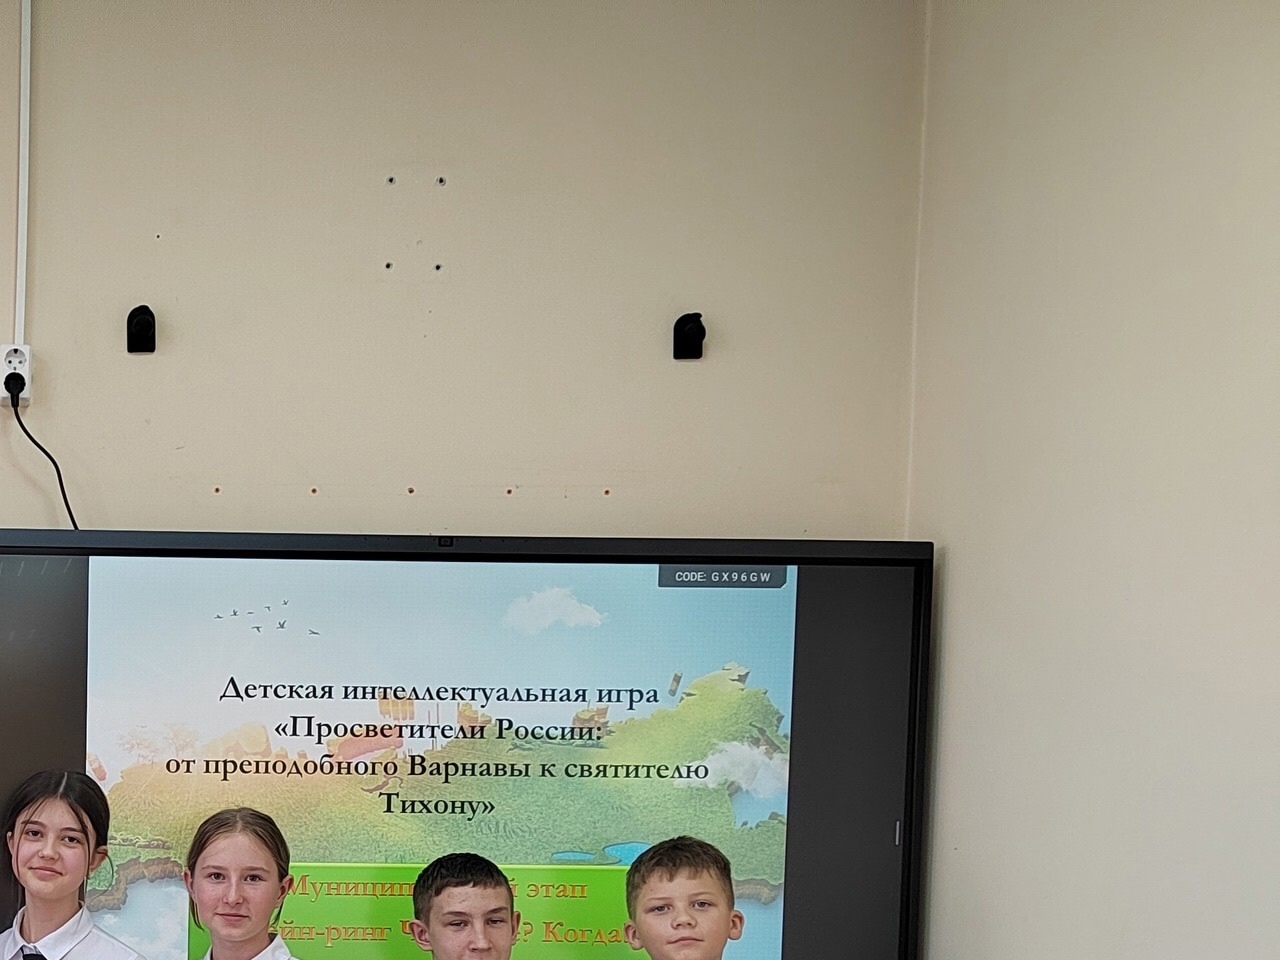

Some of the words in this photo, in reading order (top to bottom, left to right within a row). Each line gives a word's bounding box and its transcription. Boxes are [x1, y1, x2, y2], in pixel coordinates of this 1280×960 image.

[675, 572, 706, 581] CODE:
[219, 677, 334, 704] Детская
[343, 683, 587, 709] интеллектуальная
[596, 687, 659, 711] игра
[274, 714, 485, 741] «Просветители
[495, 718, 604, 741] России:
[165, 758, 195, 774] от
[203, 754, 398, 780] преподобного
[407, 755, 530, 778] Варнавы
[540, 762, 557, 778] к
[564, 762, 708, 782] святителю
[378, 792, 495, 820] Тихону»
[526, 883, 588, 898] этап
